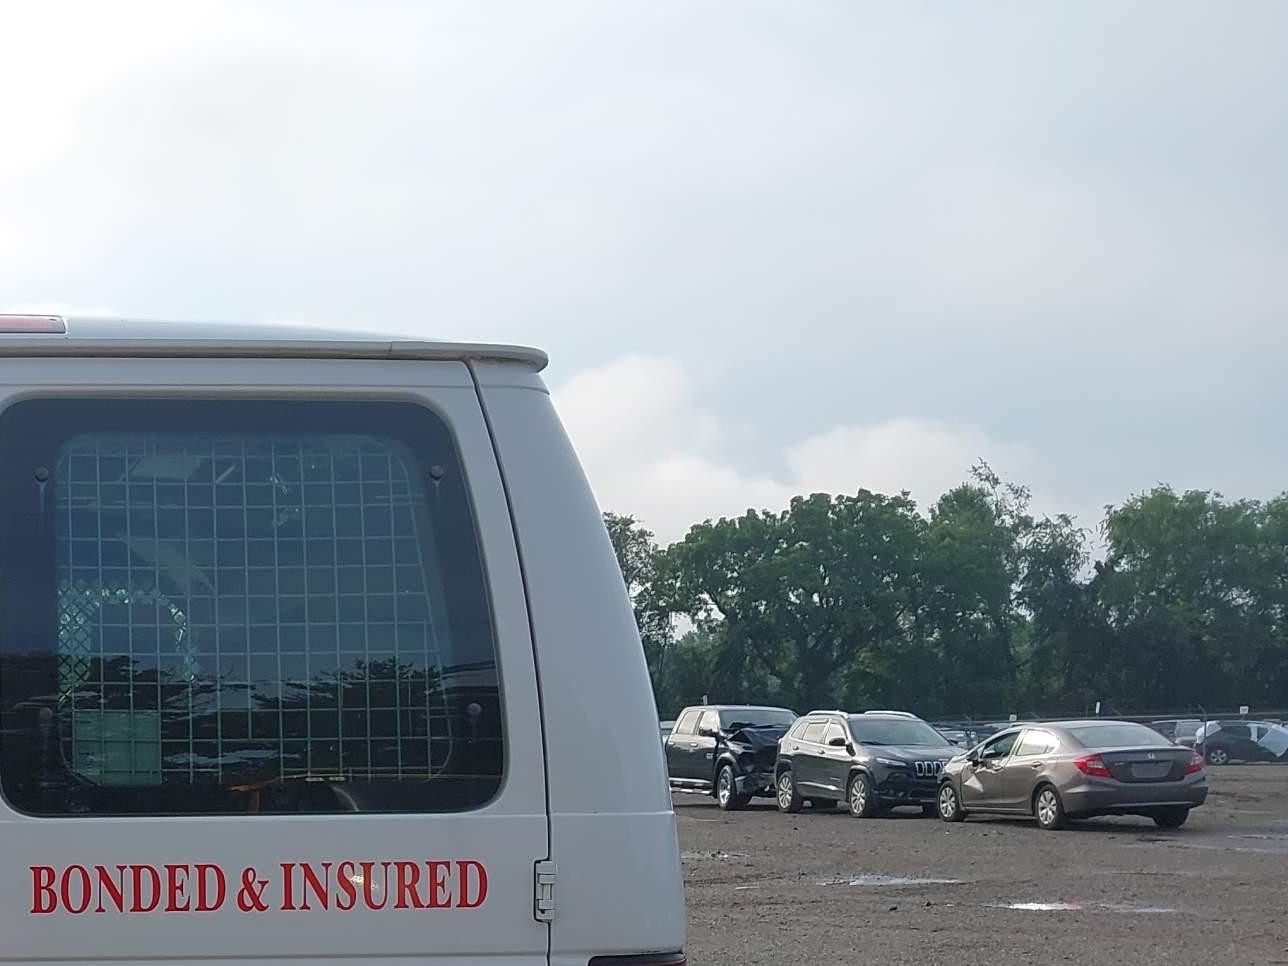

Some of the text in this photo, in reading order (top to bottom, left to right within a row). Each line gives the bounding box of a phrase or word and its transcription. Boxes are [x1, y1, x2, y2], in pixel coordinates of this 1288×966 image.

[29, 861, 488, 913] BONDED & INSURED
